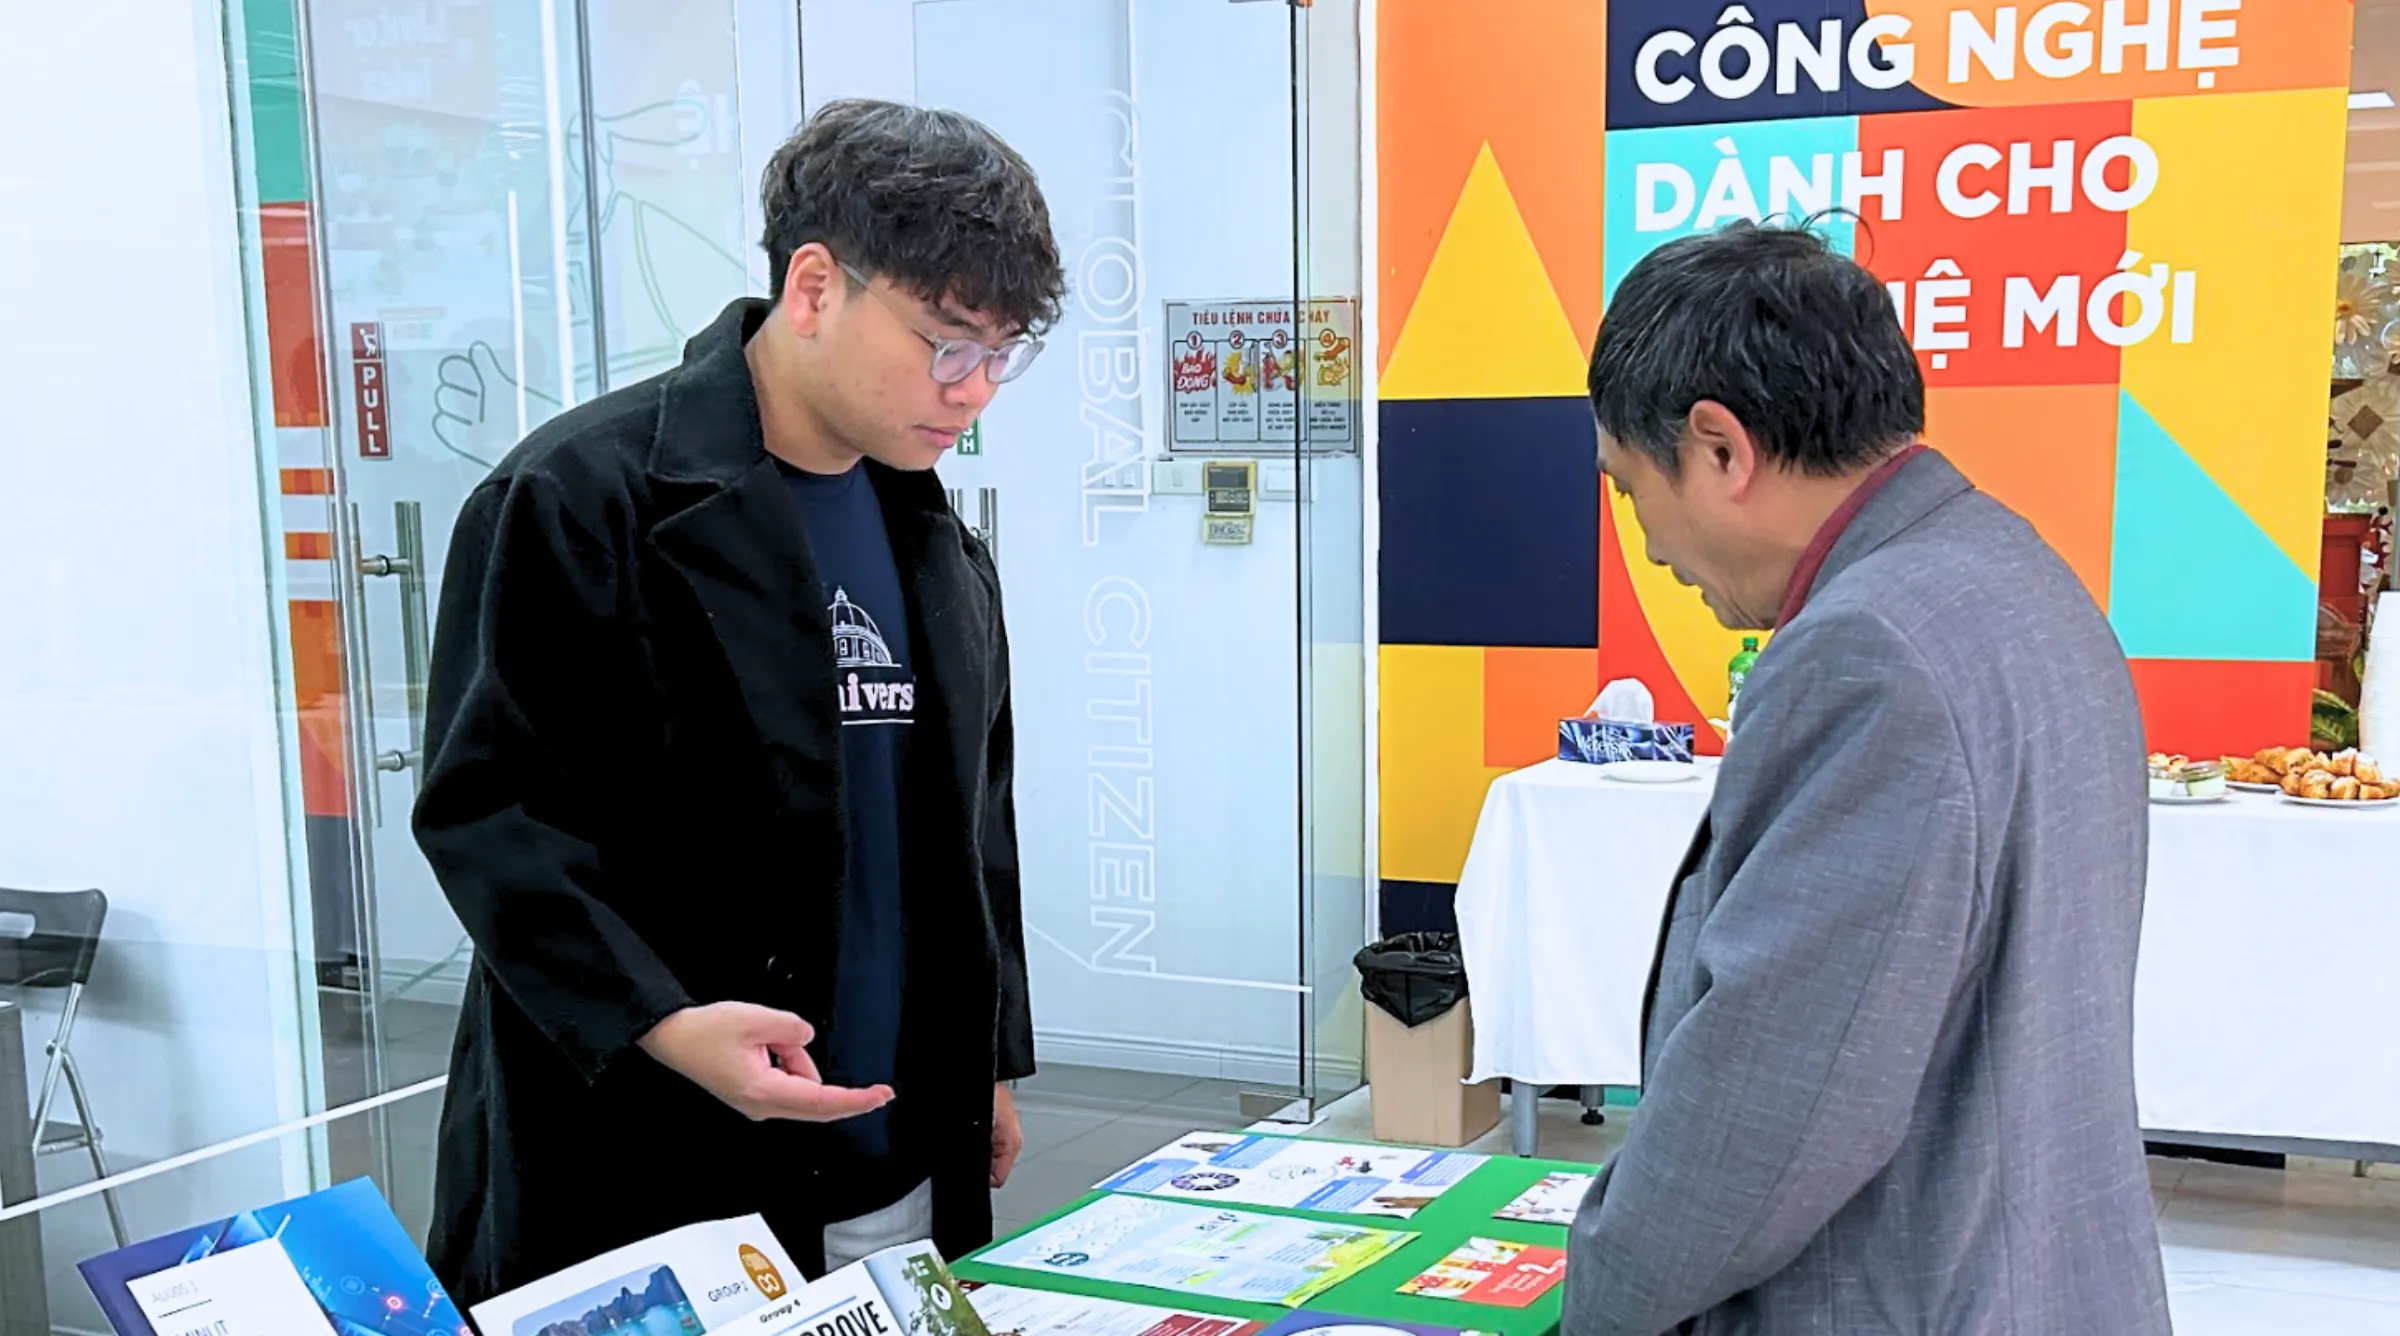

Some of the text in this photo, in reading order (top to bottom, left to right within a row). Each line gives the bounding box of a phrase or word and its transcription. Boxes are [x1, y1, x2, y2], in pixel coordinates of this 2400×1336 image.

[1635, 5, 1915, 104] CÔNG
[1635, 135, 2159, 231] DÀNH CHO
[1232, 334, 1241, 345] 2
[1275, 333, 1284, 344] 3
[1886, 249, 2196, 369] Ệ MỚI
[363, 366, 381, 453] PULL
[1083, 575, 1156, 974] CITIZEN
